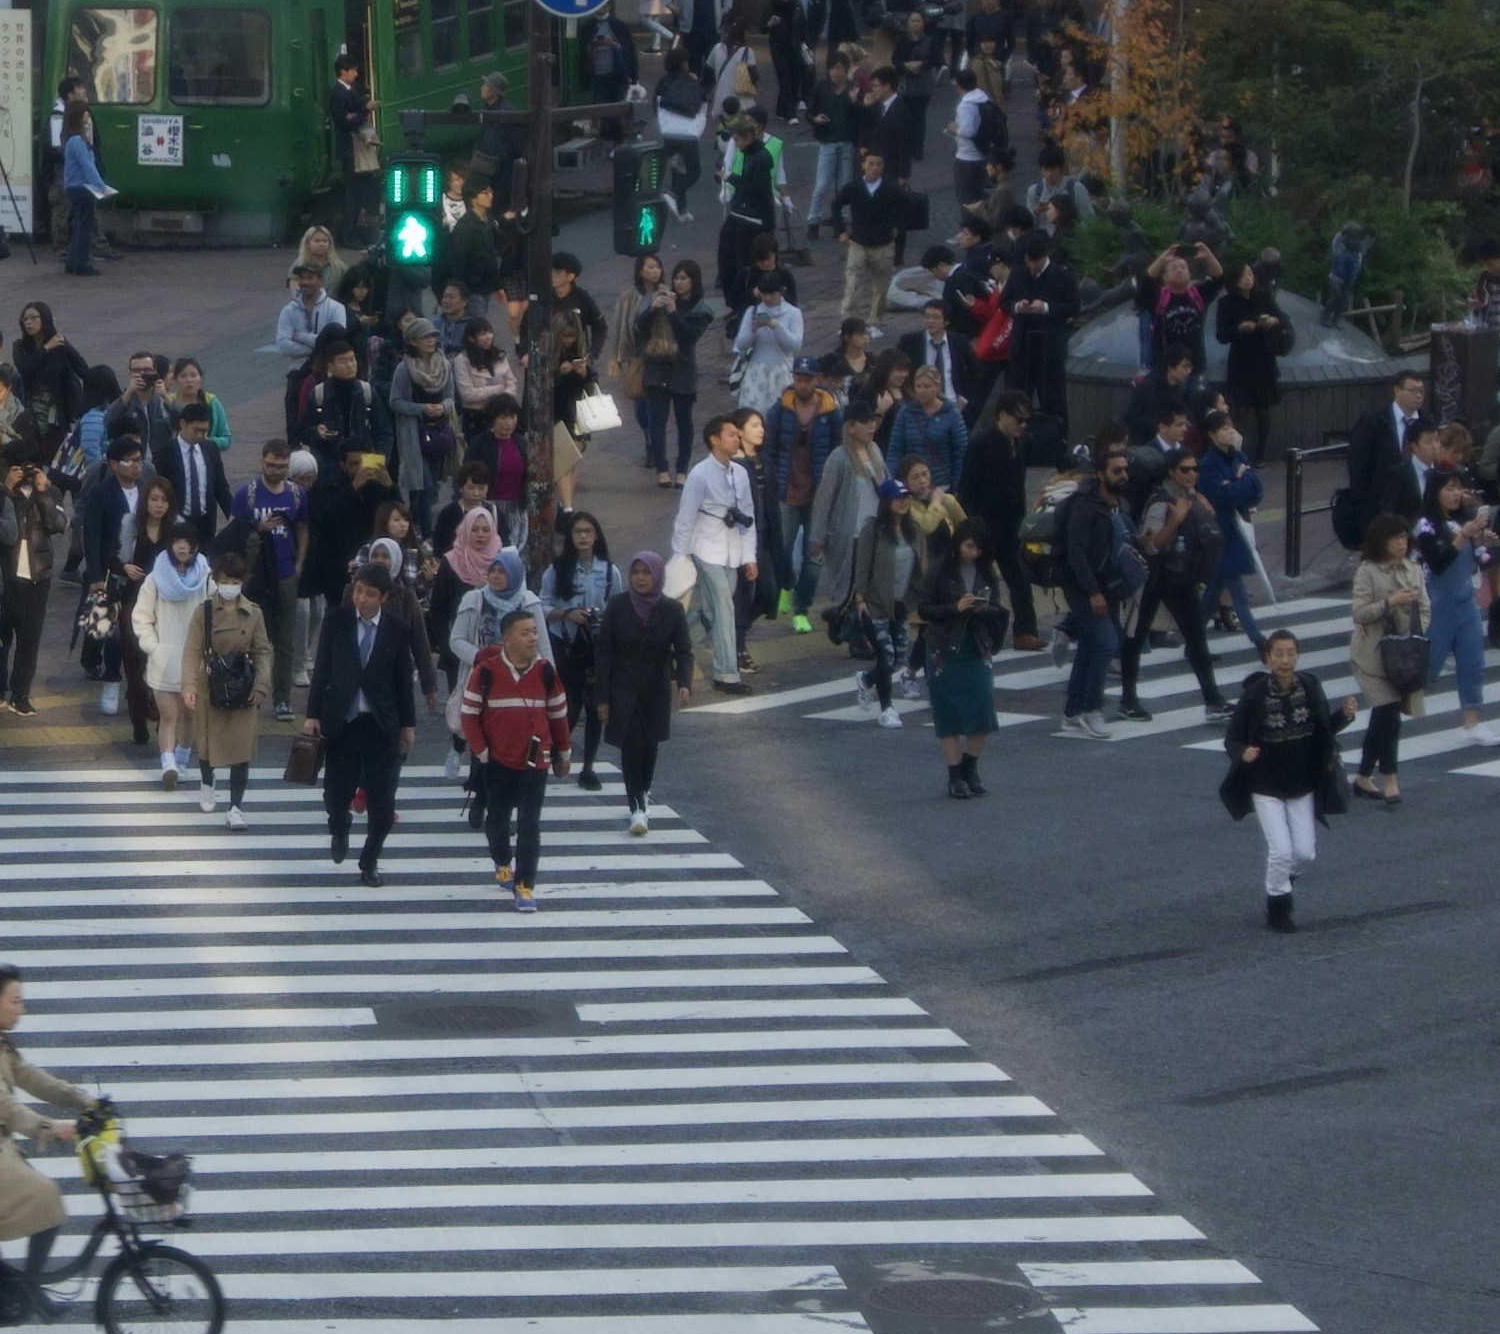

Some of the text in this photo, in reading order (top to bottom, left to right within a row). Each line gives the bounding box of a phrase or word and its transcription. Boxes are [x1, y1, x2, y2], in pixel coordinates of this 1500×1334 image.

[15, 22, 26, 102] 世界の渋谷へ。
